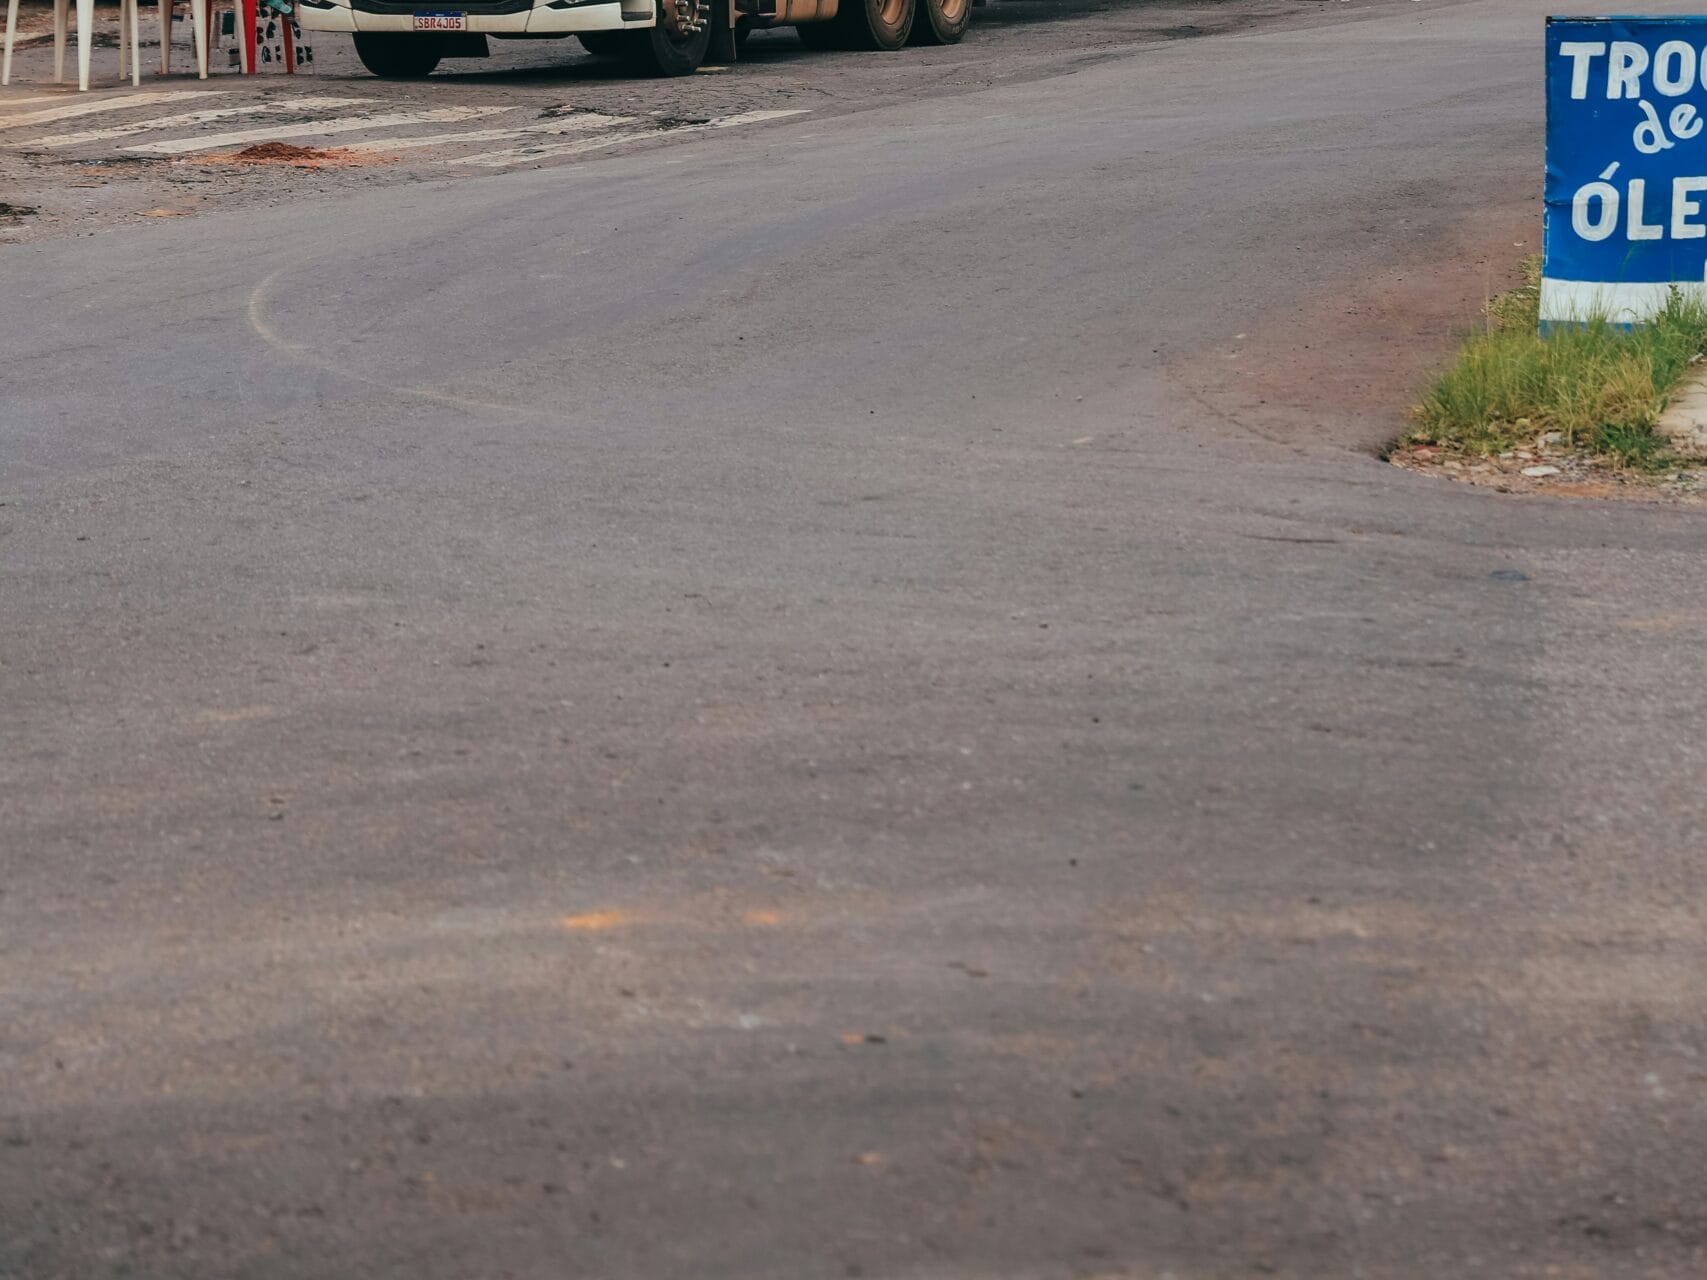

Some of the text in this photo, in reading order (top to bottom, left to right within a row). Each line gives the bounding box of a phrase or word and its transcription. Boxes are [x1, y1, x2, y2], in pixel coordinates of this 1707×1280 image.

[418, 17, 461, 29] SBR4J05
[1559, 40, 1707, 99] TRO
[1633, 99, 1703, 154] de
[1571, 161, 1707, 242] ÓLE
